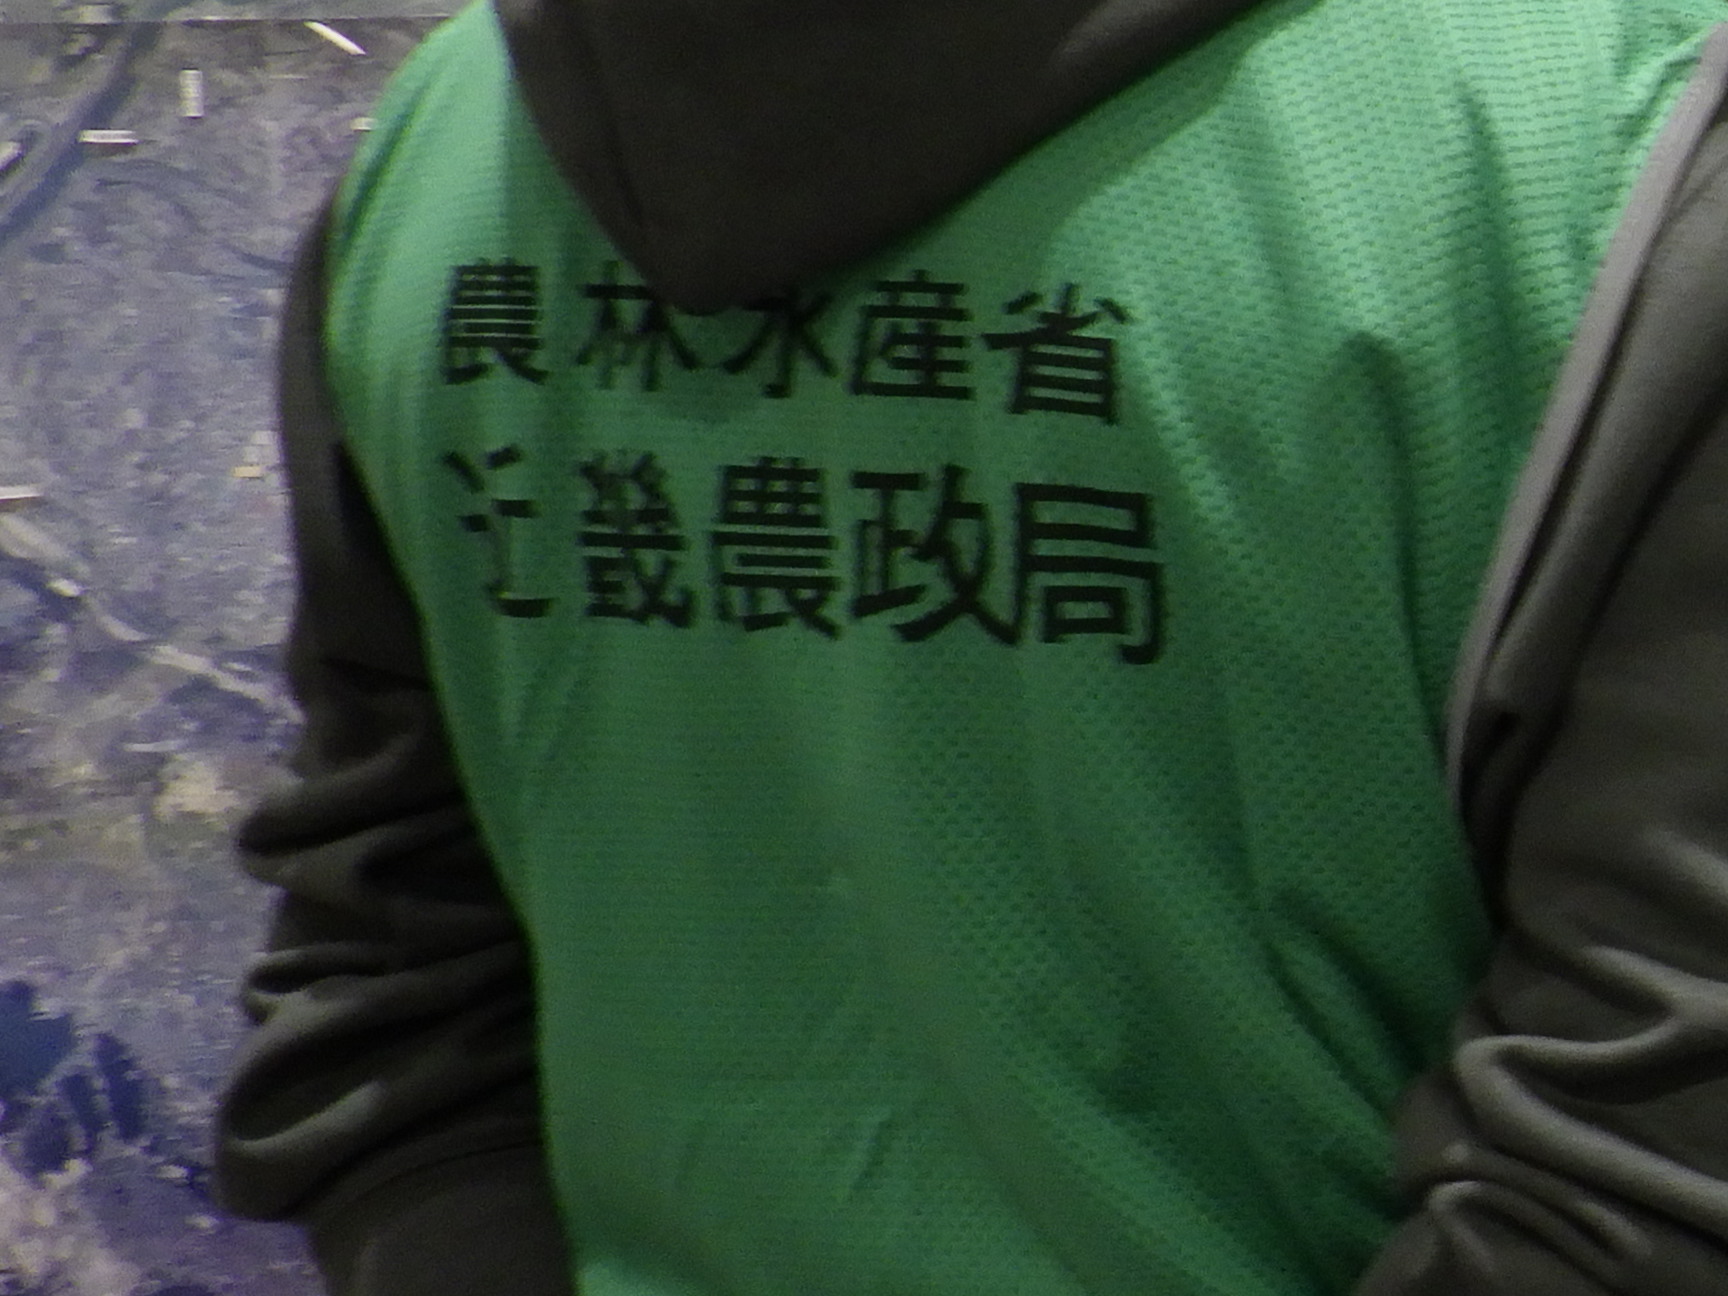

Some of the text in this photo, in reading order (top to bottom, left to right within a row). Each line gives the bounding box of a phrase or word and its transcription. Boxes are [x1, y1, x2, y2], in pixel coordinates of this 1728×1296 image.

[439, 258, 1130, 424] 農林水産省
